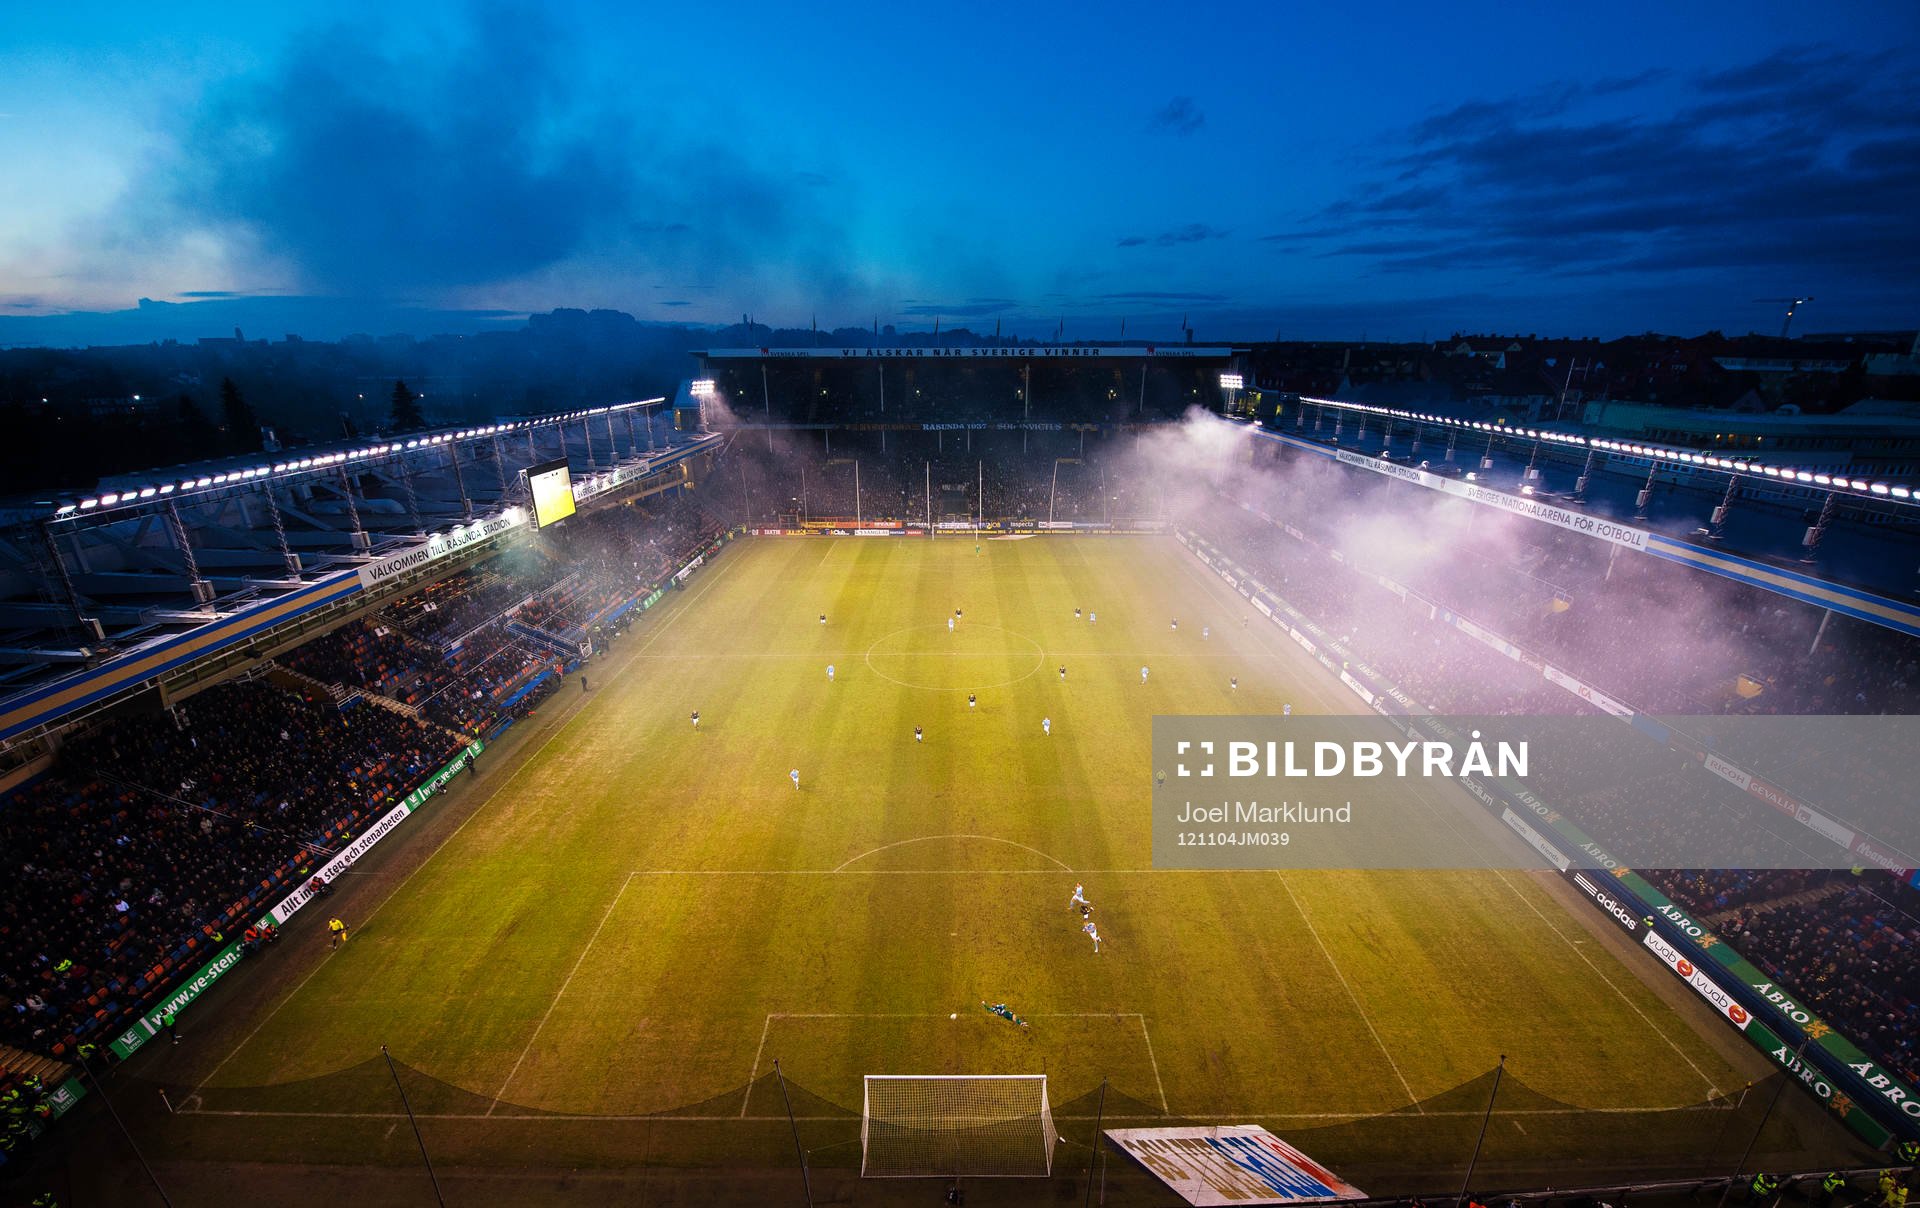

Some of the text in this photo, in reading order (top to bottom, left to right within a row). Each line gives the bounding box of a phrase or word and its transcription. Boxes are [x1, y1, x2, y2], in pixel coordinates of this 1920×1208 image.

[866, 347, 924, 357] ÄLSKAR
[933, 347, 962, 357] NÄR
[972, 348, 1035, 357] SVERIGE
[1044, 348, 1100, 357] VINNER
[1339, 451, 1365, 465] VÄLKOMMEN
[1365, 458, 1373, 468] TILL
[1398, 467, 1421, 481] STADION
[1467, 487, 1642, 546] SVERIGES NATIONALARENA FÖR FOTBOLL
[369, 549, 429, 580] VÄLKOMMEN
[430, 546, 446, 557] TILL
[483, 518, 511, 536] STADION
[1578, 685, 1592, 700] ICA
[1709, 759, 1745, 784] RICOH
[1515, 791, 1549, 815] ÅBRO
[1750, 782, 1795, 814] GEVALIA
[280, 896, 302, 917] Allt
[324, 861, 345, 880] sten
[359, 809, 405, 851] stenarbeten
[1540, 843, 1560, 863] friends
[1580, 842, 1616, 869] ÅBRO
[1856, 842, 1906, 877] Marabou
[1596, 892, 1637, 931] adidas
[1656, 904, 1702, 937] ÅBRO
[1648, 934, 1678, 963] vuab
[1696, 976, 1729, 1008] vuab
[1752, 982, 1810, 1024] ÅBRO
[120, 1030, 138, 1045] VE
[1771, 1046, 1831, 1098] ÅBRO
[51, 1088, 70, 1104] VE
[1847, 1062, 1920, 1118] ÅBRO
